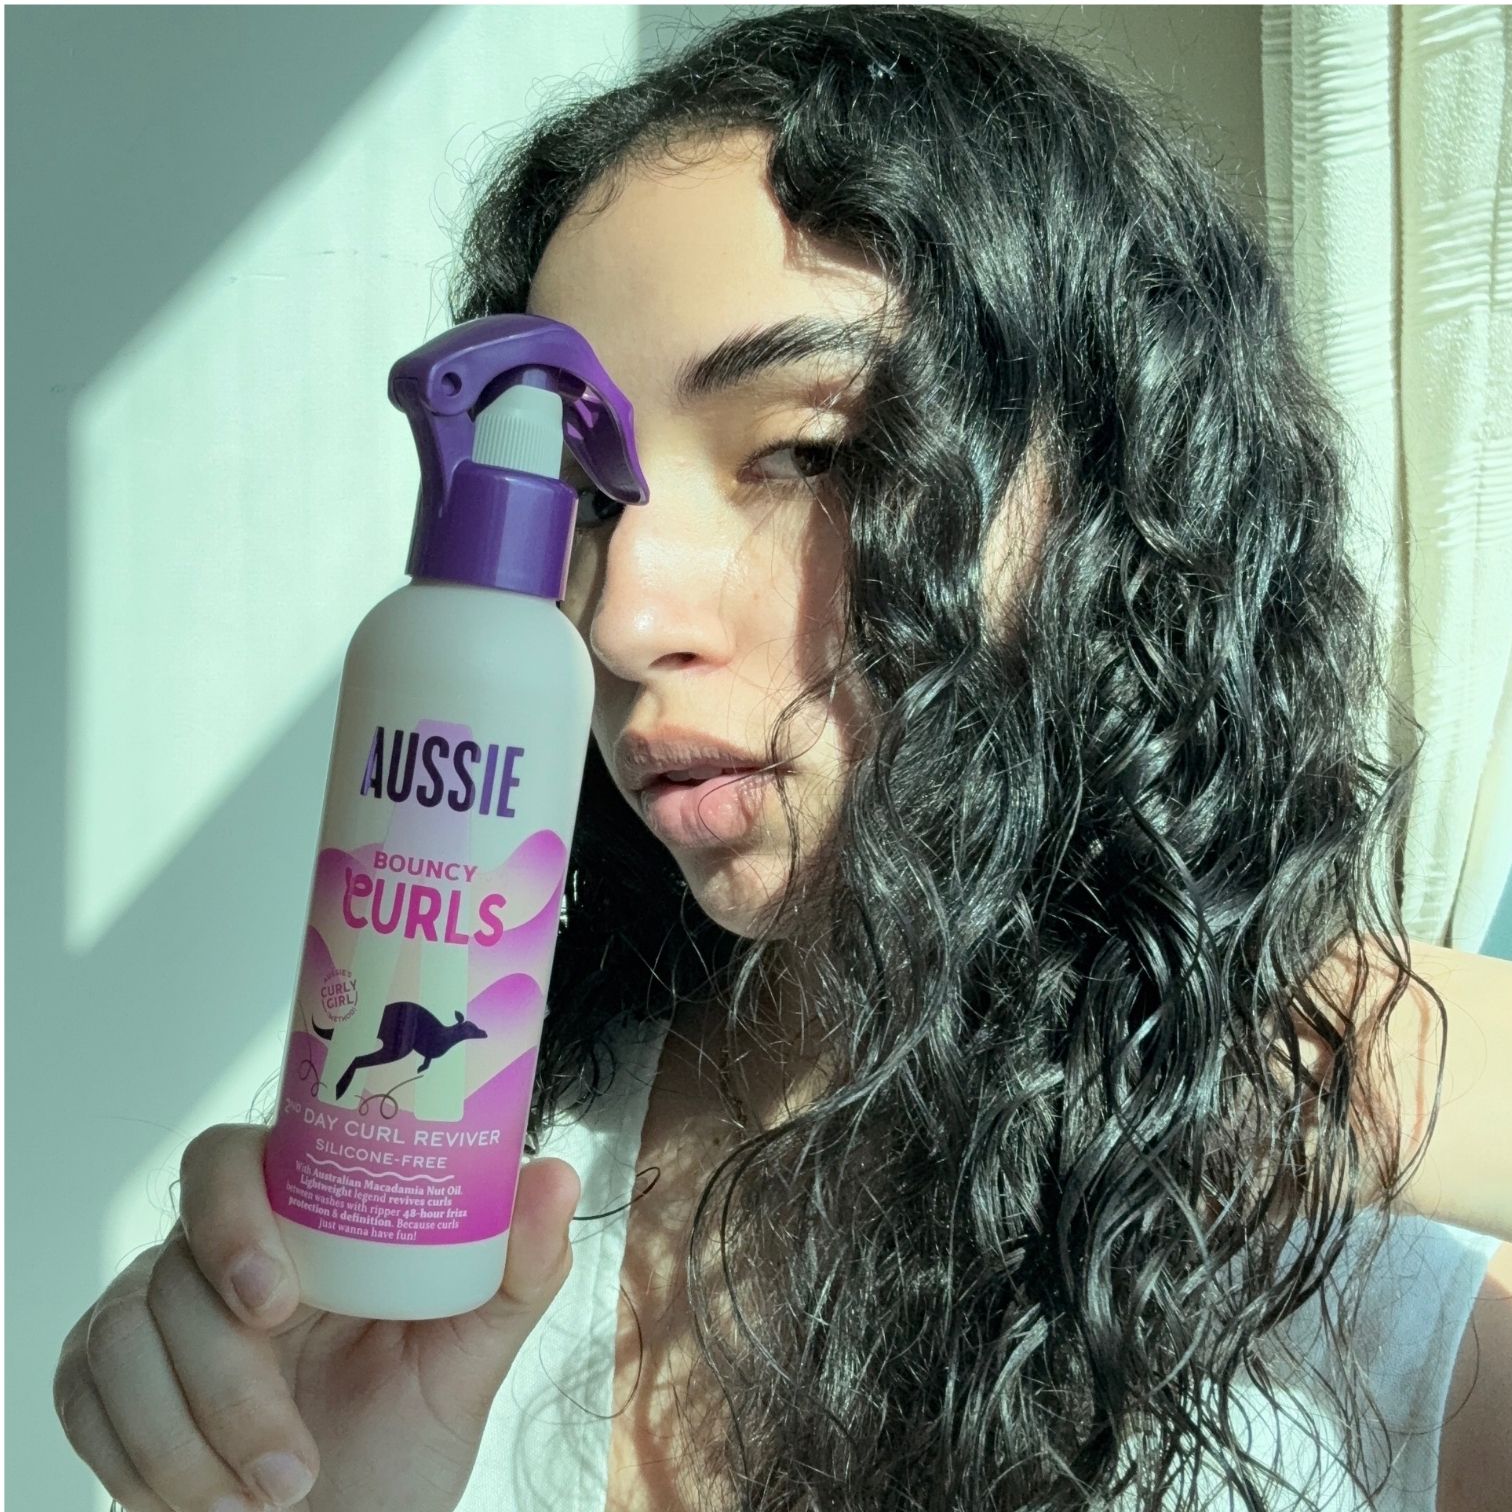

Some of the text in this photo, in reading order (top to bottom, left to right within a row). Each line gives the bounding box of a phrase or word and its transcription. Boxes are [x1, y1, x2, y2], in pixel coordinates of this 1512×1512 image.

[360, 726, 525, 818] AUSSIE
[373, 851, 478, 883] BOUNCY
[342, 868, 507, 948] CURLS
[321, 979, 357, 998] CURLY
[327, 994, 354, 1008] GIRL
[304, 1109, 338, 1131] DAY
[345, 1121, 405, 1144] CURL
[414, 1130, 501, 1147] REVIVER
[316, 1139, 447, 1169] SILICONE-FREE
[300, 1174, 452, 1206] Lightweight legend revives curls
[313, 1168, 361, 1188] Australian
[364, 1180, 424, 1195] Macadamia
[427, 1186, 445, 1196] Nut
[286, 1179, 468, 1219] between washes with ripper 48-hour frizz
[288, 1196, 459, 1229] protection & definition. Because curls
[318, 1218, 417, 1240] just wanna have fun!
